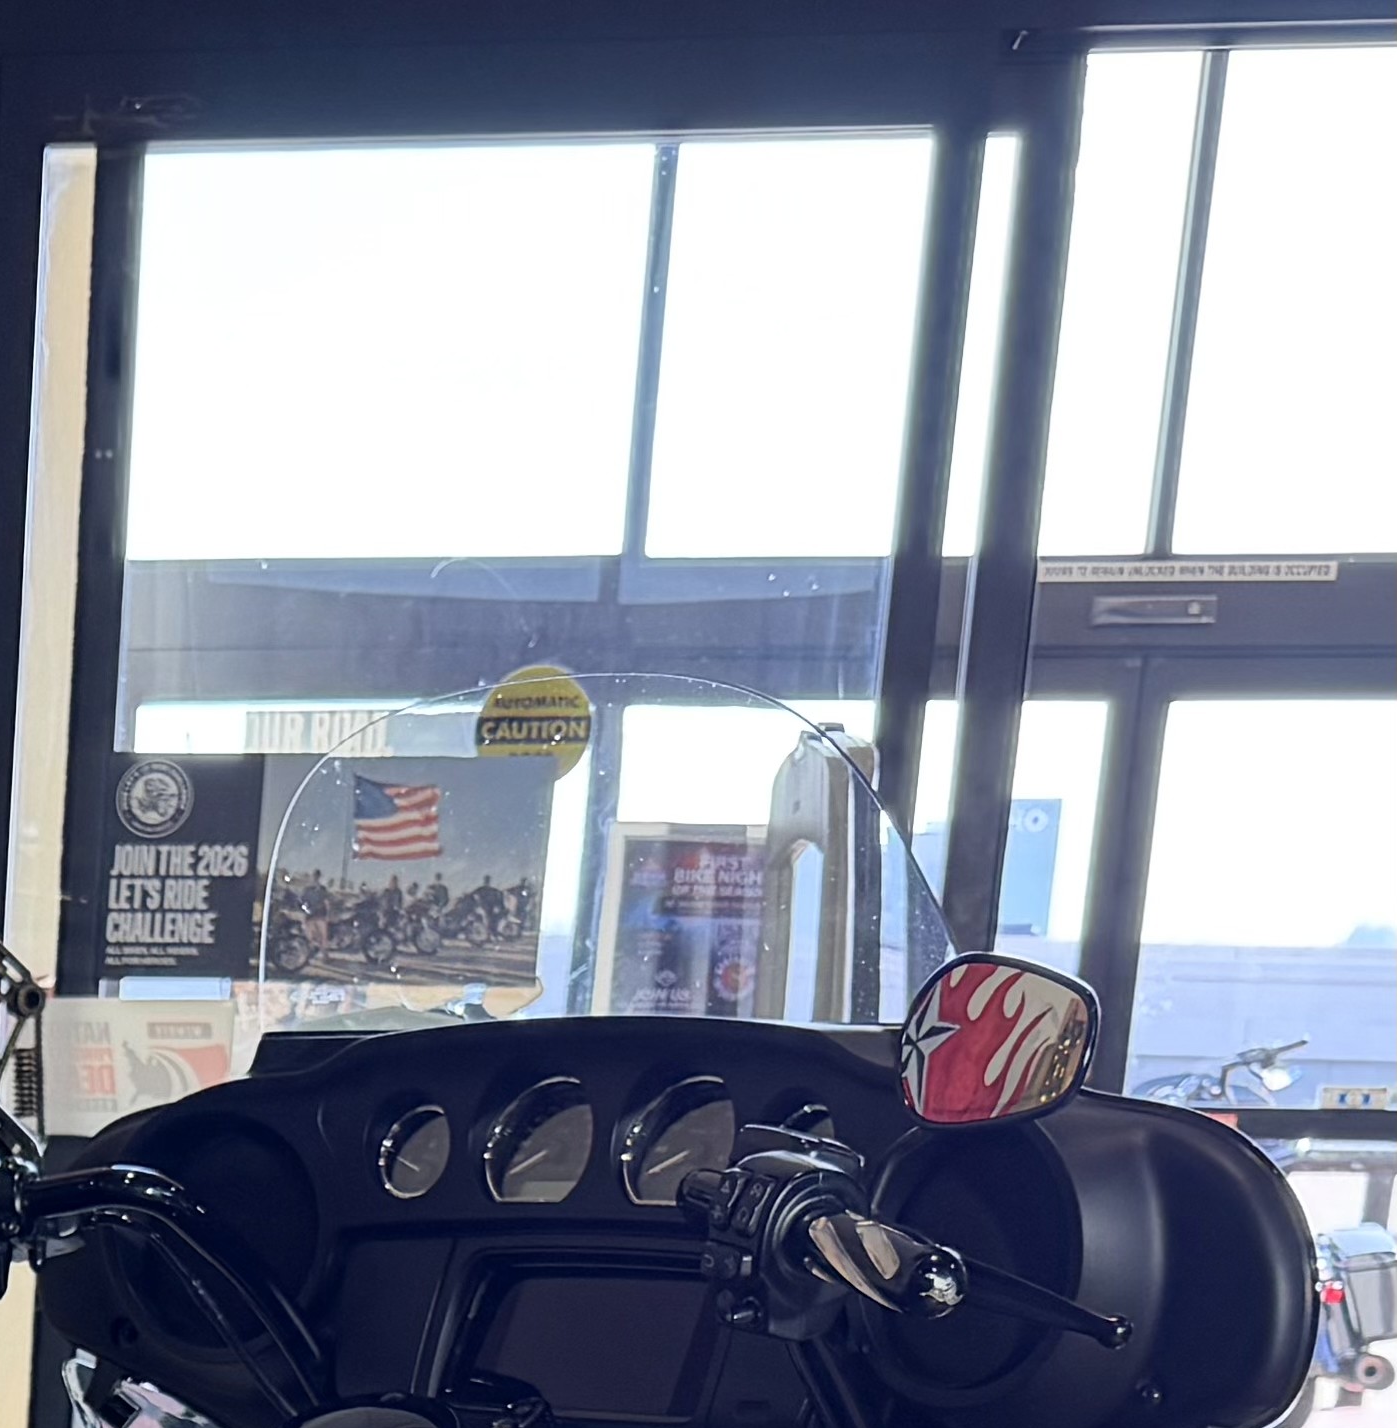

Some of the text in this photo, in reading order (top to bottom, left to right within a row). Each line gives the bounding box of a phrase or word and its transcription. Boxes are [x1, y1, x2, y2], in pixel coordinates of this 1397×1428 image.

[493, 695, 581, 711] AUTOMATIC
[481, 720, 588, 741] CAUTION
[110, 844, 249, 877] JOIN THE 2026
[718, 869, 763, 885] NIGH
[108, 878, 210, 911] LET'S RIDE
[106, 911, 217, 944] CHALLENGE
